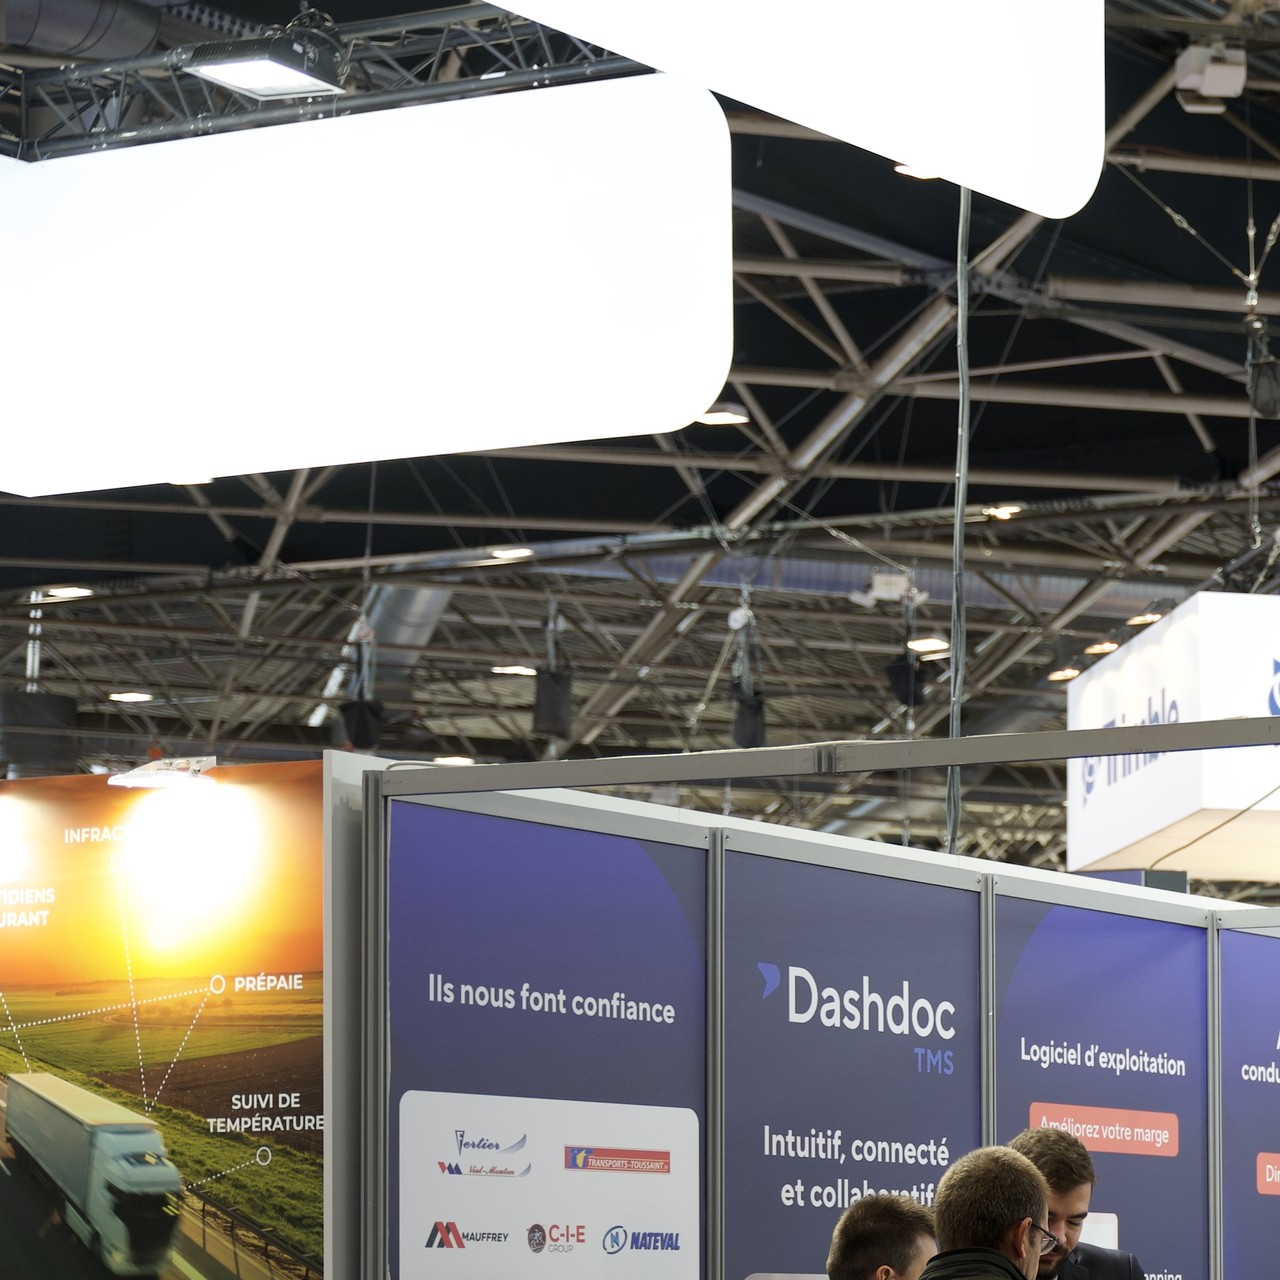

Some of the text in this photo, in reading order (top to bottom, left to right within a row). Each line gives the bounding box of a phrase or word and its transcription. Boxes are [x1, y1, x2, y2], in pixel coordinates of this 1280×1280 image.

[0, 888, 55, 905] IDIENS
[234, 972, 303, 992] PRÉPAIE
[429, 973, 676, 1024] Ils nous font confiance
[788, 966, 956, 1040] Dashdoc
[914, 1047, 954, 1075] TMS
[1021, 1037, 1185, 1076] Logiciel d'exploitation
[231, 1093, 300, 1110] SUIVI DE
[207, 1112, 324, 1132] TEMPÉRATURE
[764, 1125, 949, 1166] Intuitif, connecté
[1101, 1124, 1131, 1141] votre
[1134, 1129, 1169, 1147] marge
[781, 1179, 804, 1206] et
[462, 1232, 509, 1243] MAUFFREY
[549, 1225, 585, 1243] C-I-E
[630, 1232, 680, 1251] NATEVAL
[548, 1244, 573, 1253] GROUP
